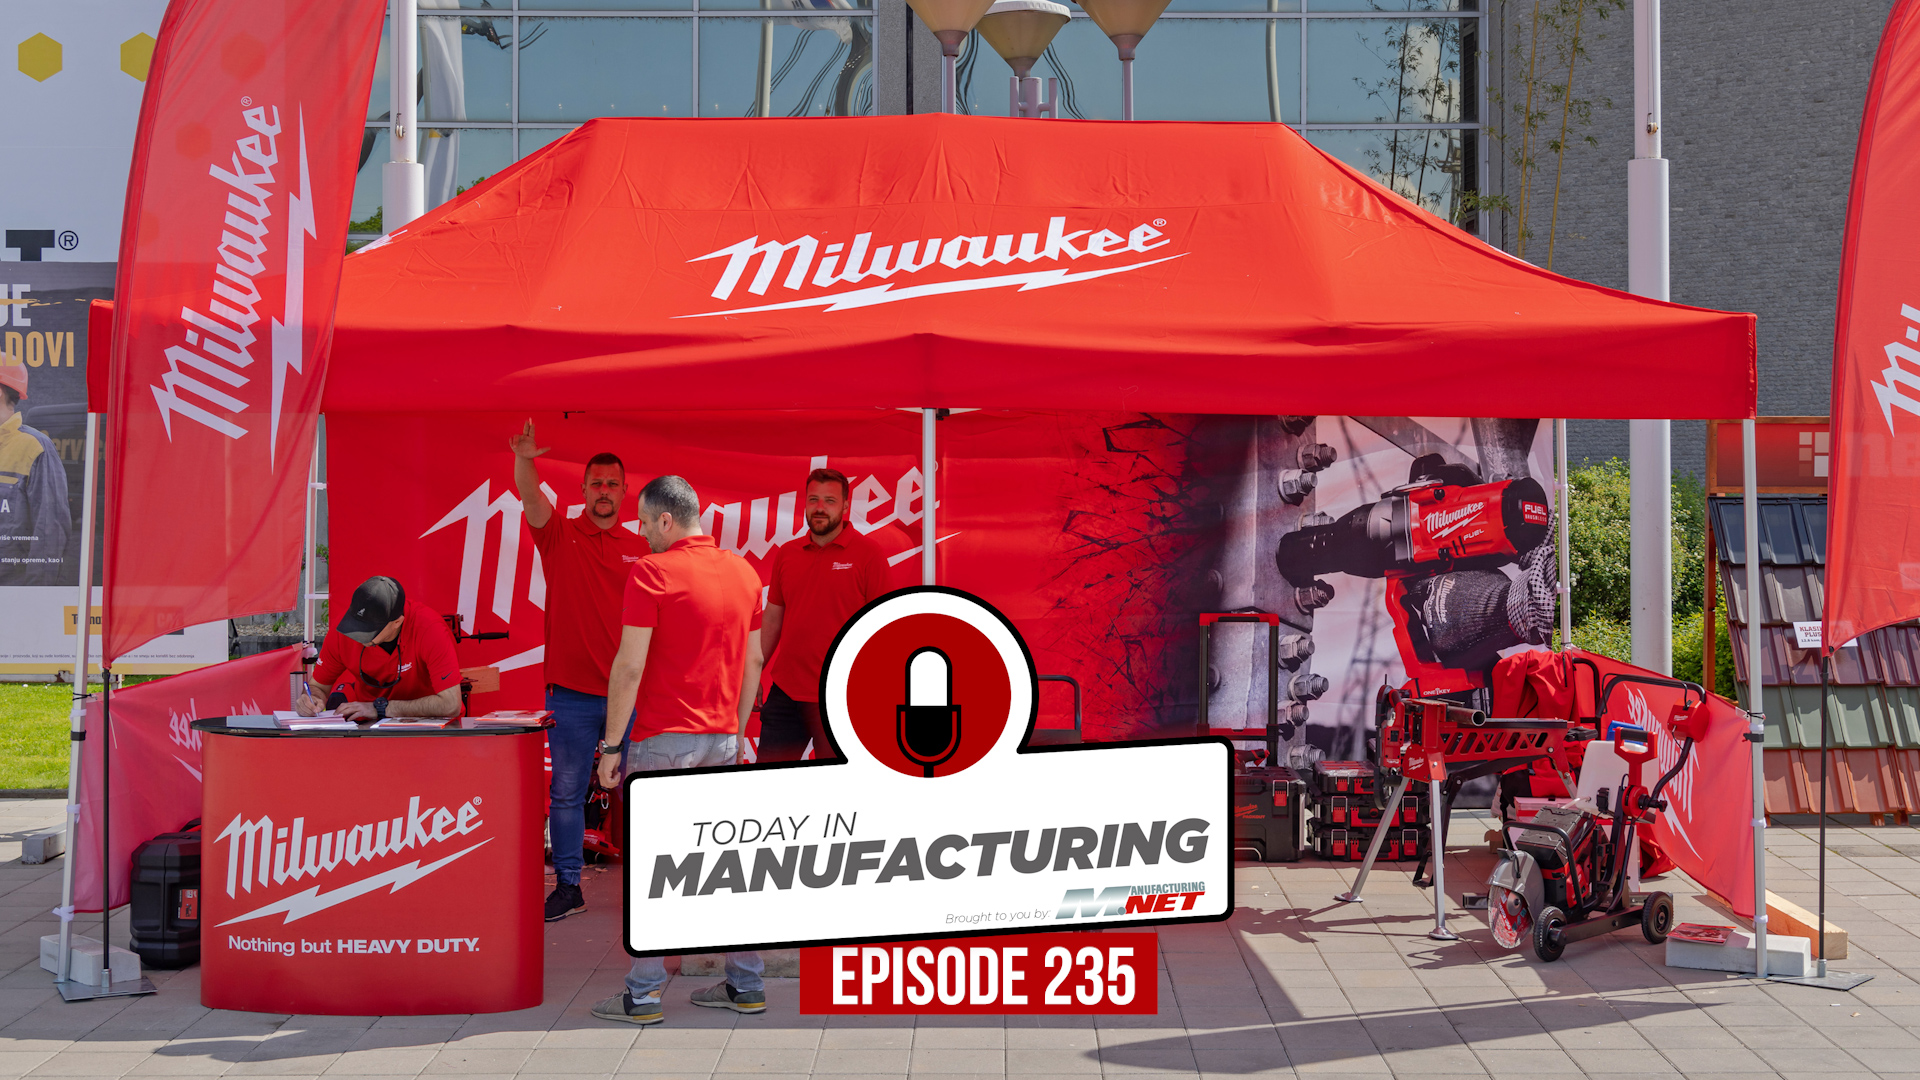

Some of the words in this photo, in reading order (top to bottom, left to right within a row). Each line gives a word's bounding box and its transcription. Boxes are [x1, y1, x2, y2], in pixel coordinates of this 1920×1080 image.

[0, 331, 75, 368] DOVI
[1524, 504, 1547, 516] FUEL
[228, 935, 296, 956] Nothing
[300, 938, 333, 953] but
[337, 939, 412, 953] HEAVY
[417, 937, 481, 953] DUTY.
